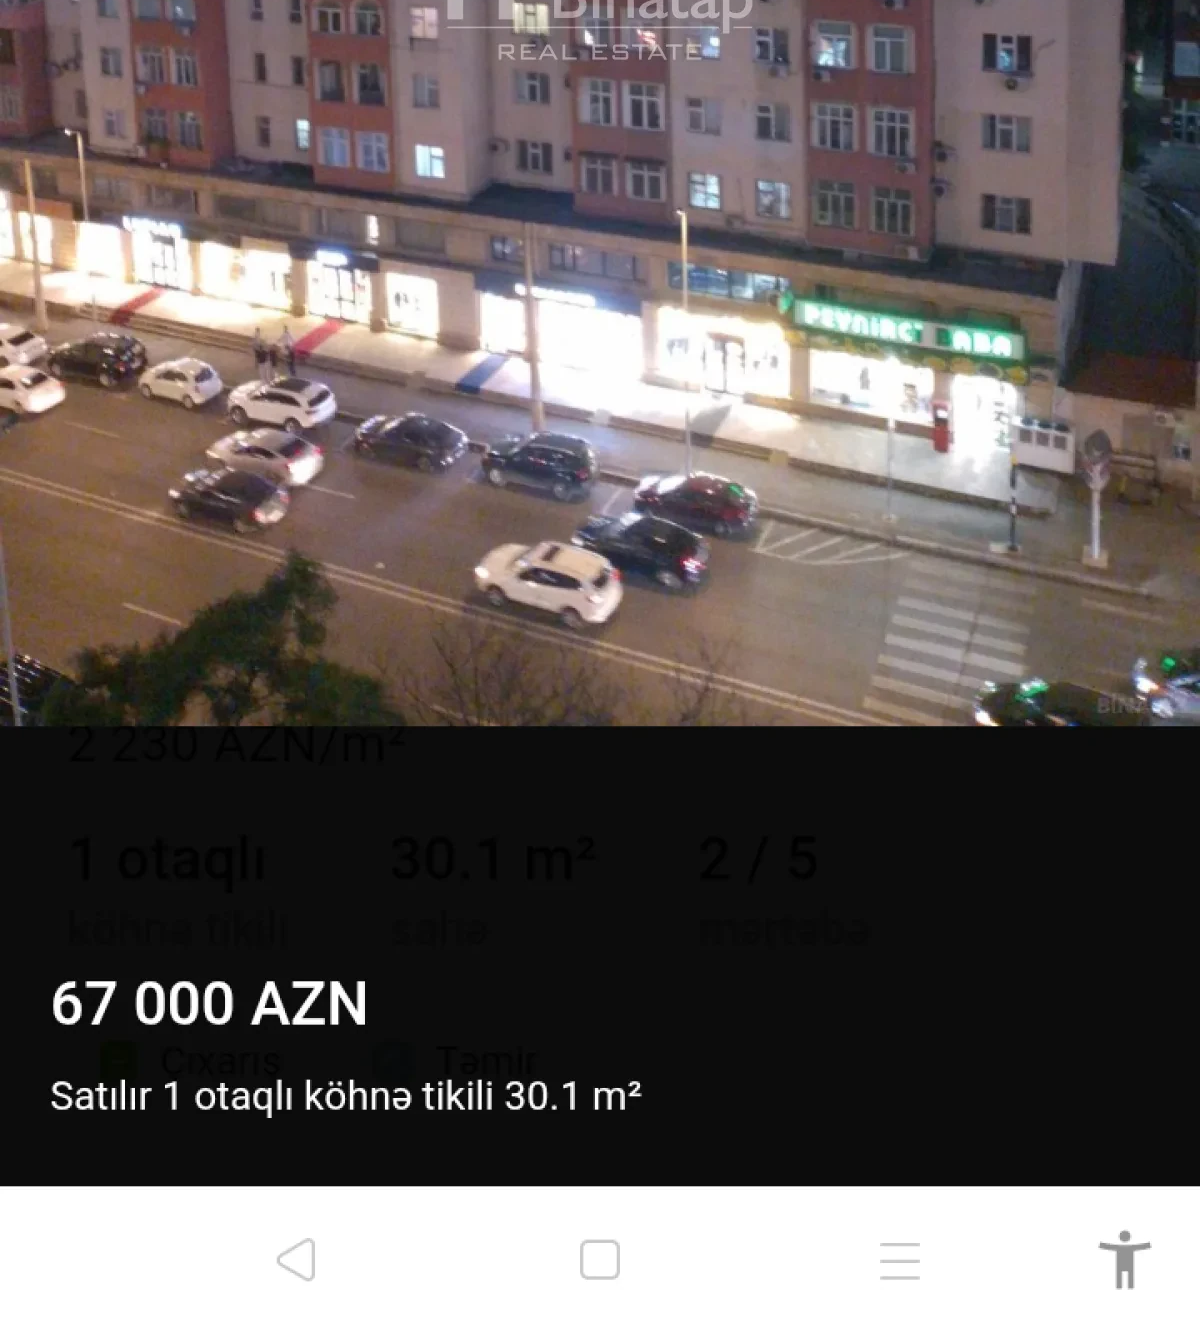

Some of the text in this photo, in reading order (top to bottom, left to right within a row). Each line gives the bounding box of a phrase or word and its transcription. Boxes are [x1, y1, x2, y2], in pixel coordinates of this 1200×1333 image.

[71, 834, 266, 894] 1 otaqlı
[391, 835, 598, 881] 30.1 m²
[698, 836, 732, 881] 2
[787, 835, 818, 881] 5
[51, 980, 368, 1027] 67 000 AZN
[50, 1079, 643, 1119] Satılır 1 otaqlı köhnə tikili 30.1 m²
